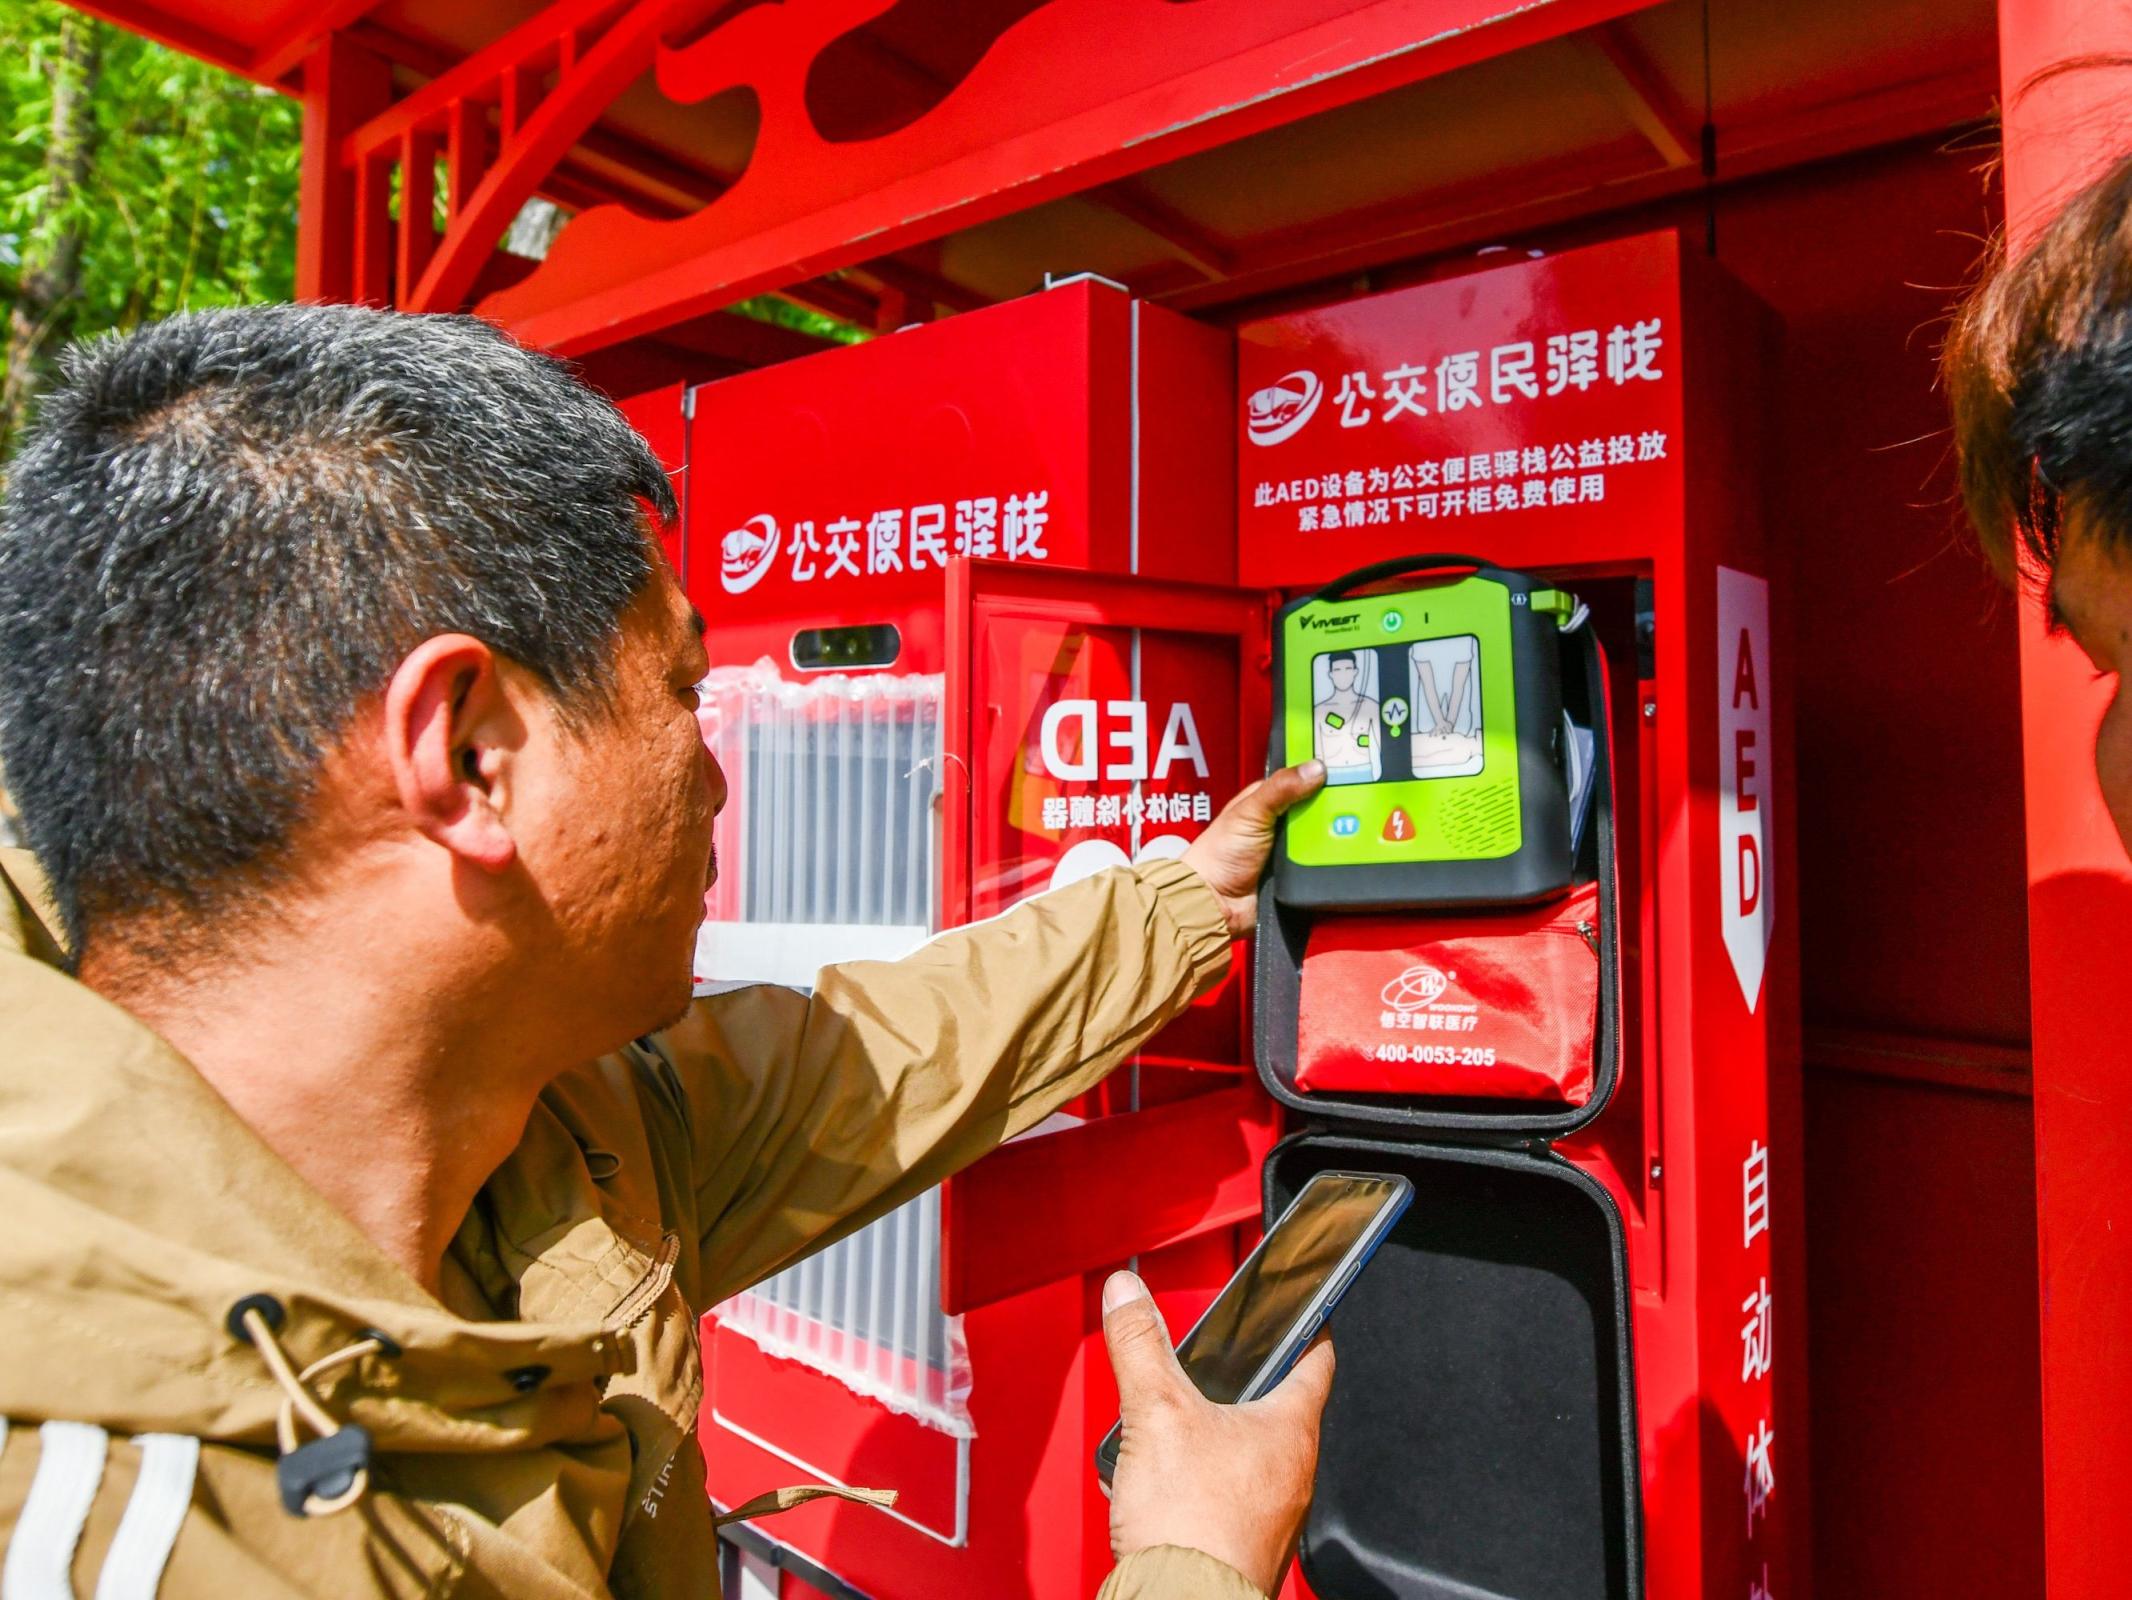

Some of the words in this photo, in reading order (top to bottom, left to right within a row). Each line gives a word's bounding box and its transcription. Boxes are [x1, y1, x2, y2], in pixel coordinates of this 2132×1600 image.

[1333, 318, 1664, 429] 公交便民驿栈
[1253, 430, 1668, 508] 此AED设备为公交便民驿栈公益投放
[1298, 474, 1606, 532] 紧急情况下可开柜免费使用
[786, 490, 1049, 583] 公交便民驿栈
[1732, 627, 1760, 918] AED
[1375, 1044, 1496, 1067] 400-0053-205
[1379, 1010, 1479, 1032] 悟空智联医疗
